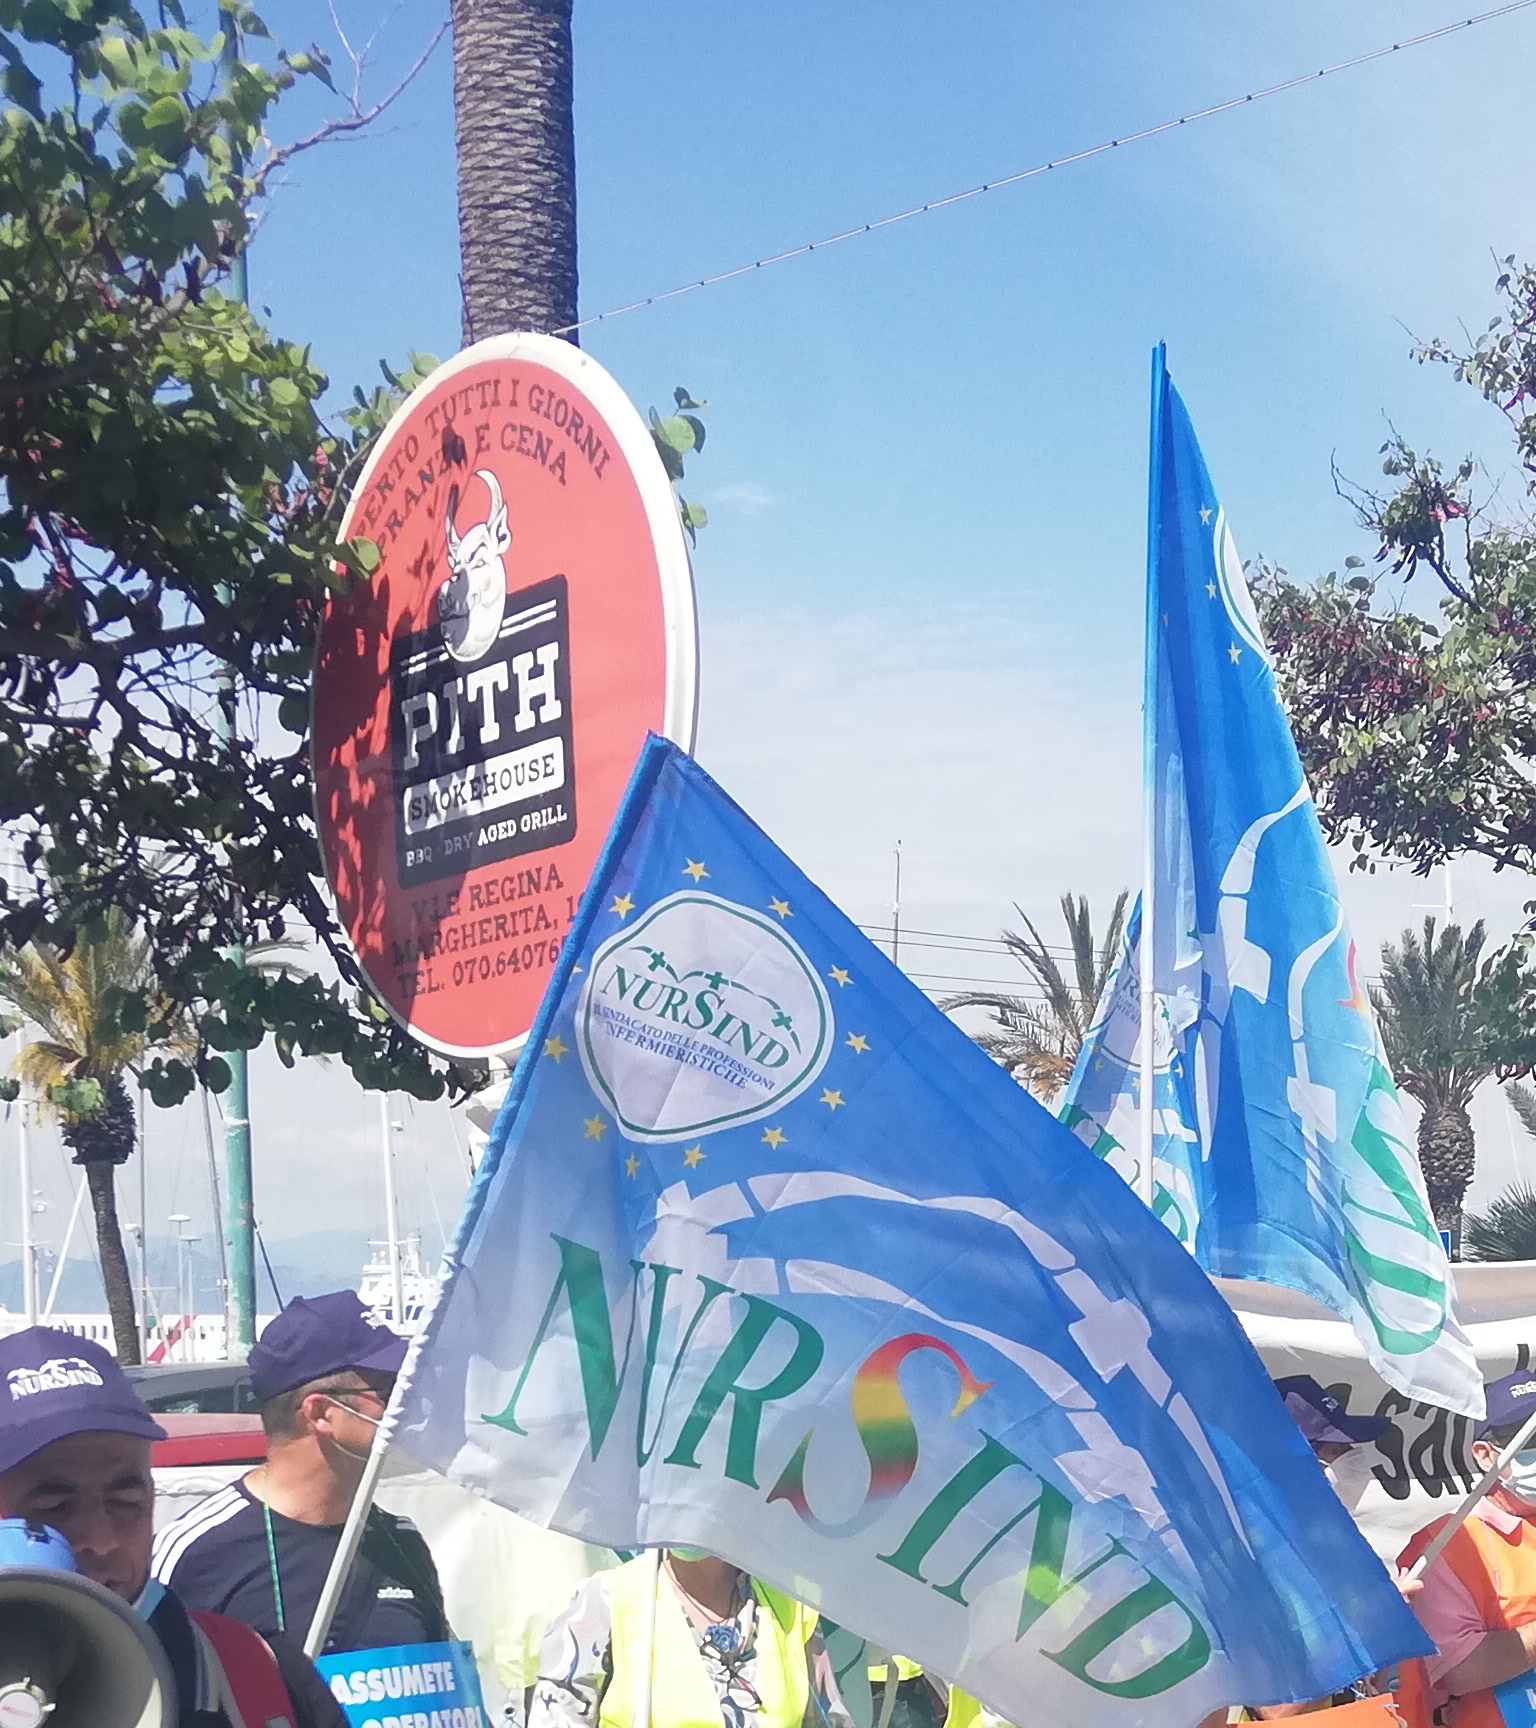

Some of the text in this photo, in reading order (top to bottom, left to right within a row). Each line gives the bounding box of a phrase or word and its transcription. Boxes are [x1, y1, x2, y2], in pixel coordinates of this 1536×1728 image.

[355, 379, 610, 537] PERTO TUTTI I GIORNI
[377, 422, 566, 566] PRANZ E CENA
[401, 642, 562, 770] PITH
[411, 753, 555, 822] SMOKEHOUSE
[444, 832, 473, 855] DRY
[477, 818, 517, 847] AGED
[521, 804, 567, 832] GRILL
[469, 864, 563, 911] REGINA
[398, 967, 445, 998] TEL.
[700, 1043, 776, 1091] PROFESSIONI
[330, 1661, 456, 1706] ASSUMETE
